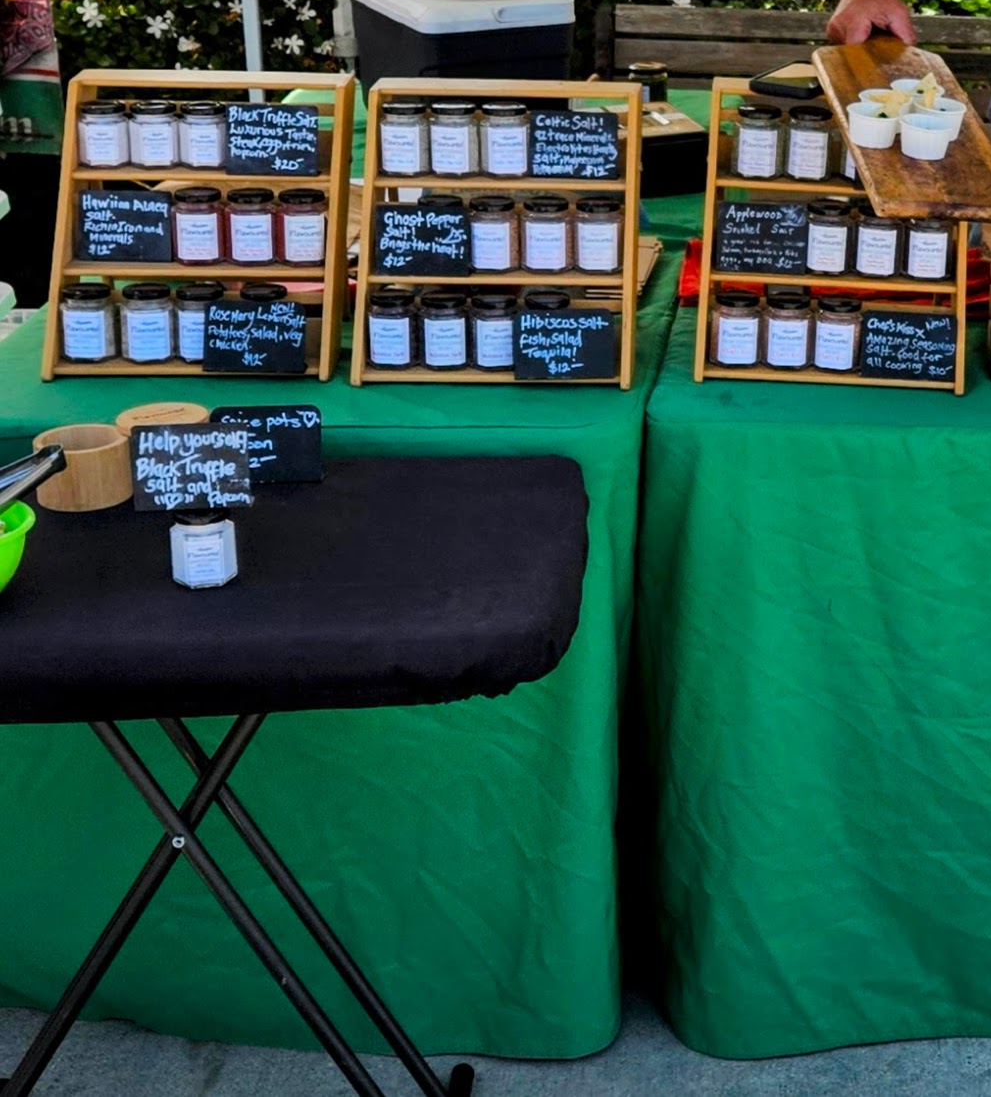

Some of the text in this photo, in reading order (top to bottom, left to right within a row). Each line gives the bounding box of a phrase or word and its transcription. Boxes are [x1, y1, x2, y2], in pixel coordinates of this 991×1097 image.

[228, 106, 260, 122] Black
[535, 114, 570, 128] Celtic
[384, 211, 425, 227] Ghost
[866, 357, 882, 367] all
[885, 361, 923, 375] cooking
[266, 412, 301, 432] pots
[139, 432, 180, 454] Help
[136, 458, 182, 480] Black
[187, 482, 212, 495] and
